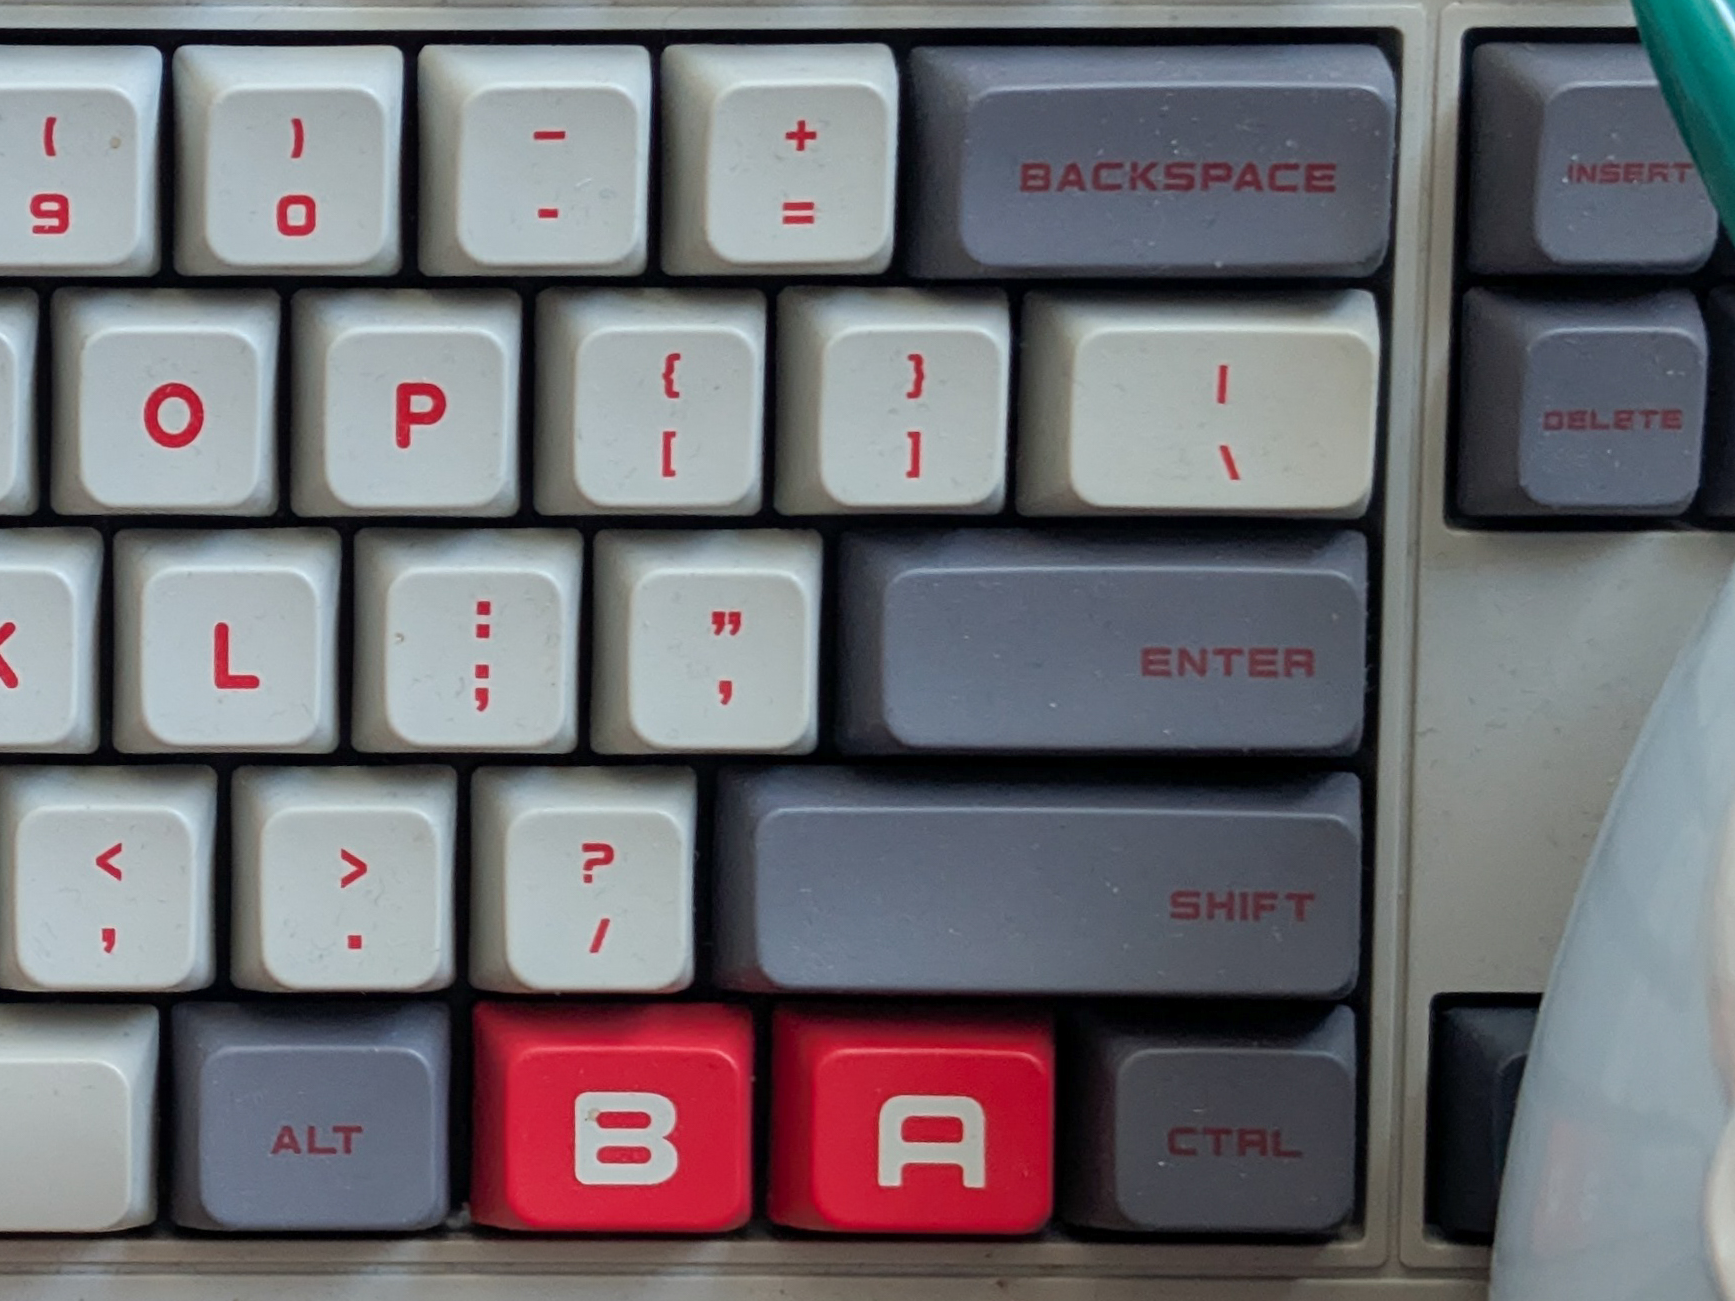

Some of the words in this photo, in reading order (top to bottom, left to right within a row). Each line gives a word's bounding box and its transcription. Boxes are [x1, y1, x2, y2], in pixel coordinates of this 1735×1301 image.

[785, 121, 817, 151] +
[1018, 161, 1336, 194] BACKSPACE
[1567, 160, 1694, 184] INSERT
[30, 193, 70, 234] 9
[276, 194, 316, 237] 0
[782, 201, 814, 225] =
[144, 383, 205, 449] O
[396, 382, 447, 449] P
[1543, 409, 1684, 431] DELETE
[476, 600, 491, 639] :
[214, 622, 260, 690] L
[1139, 645, 1316, 678] ENTER
[474, 664, 491, 711] ;
[96, 843, 122, 881] <
[341, 849, 367, 887] >
[582, 843, 614, 883] ?
[1168, 889, 1316, 921] SHIFT
[590, 919, 610, 953] /
[269, 1123, 364, 1156] ALT
[574, 1091, 678, 1186] B
[877, 1094, 986, 1189] A
[1166, 1126, 1303, 1159] CTRL
